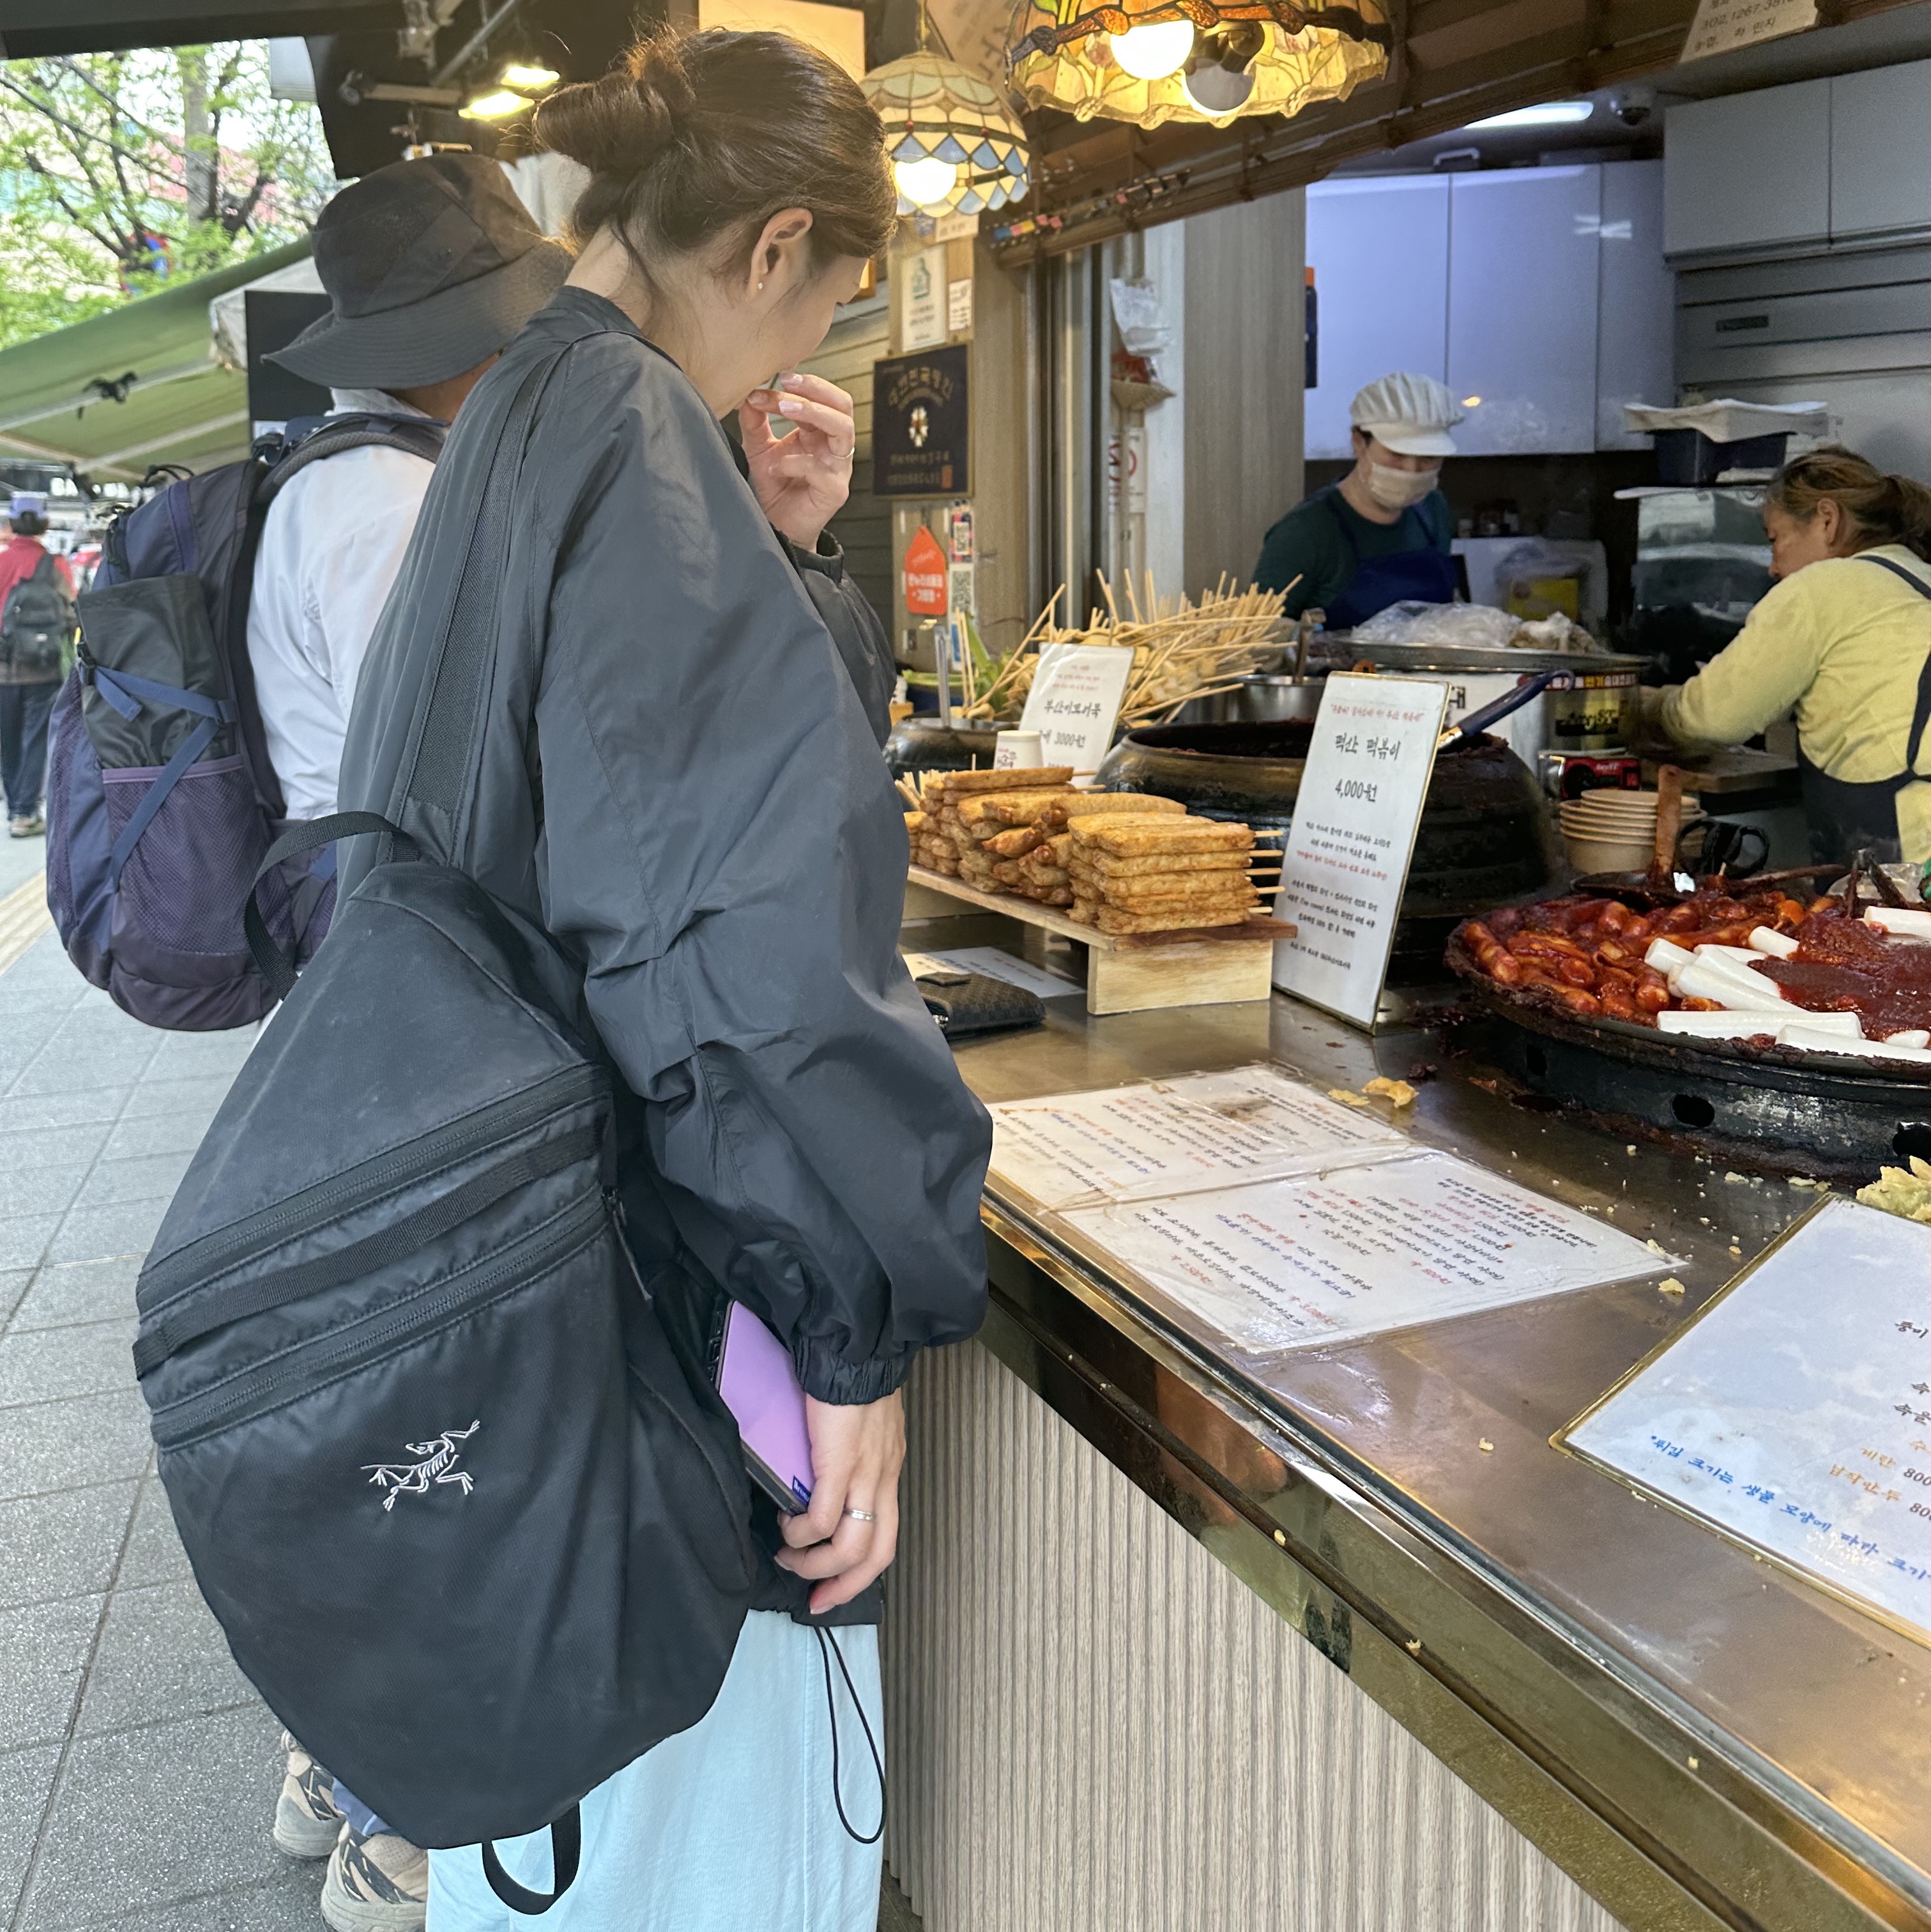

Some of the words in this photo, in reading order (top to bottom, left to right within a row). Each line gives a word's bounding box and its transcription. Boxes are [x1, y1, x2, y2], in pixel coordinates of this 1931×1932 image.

[1044, 699, 1101, 718] 부산이모어묵
[1366, 736, 1401, 760] 떡볶이
[1335, 778, 1377, 802] 4,000원
[1688, 1457, 1733, 1483] 크기는
[1741, 1484, 1775, 1504] 생물
[1780, 1503, 1832, 1532] 모양에
[1841, 1532, 1879, 1556] 따라
[1888, 1557, 1931, 1579] 크기
[1909, 1503, 1931, 1521] 80
